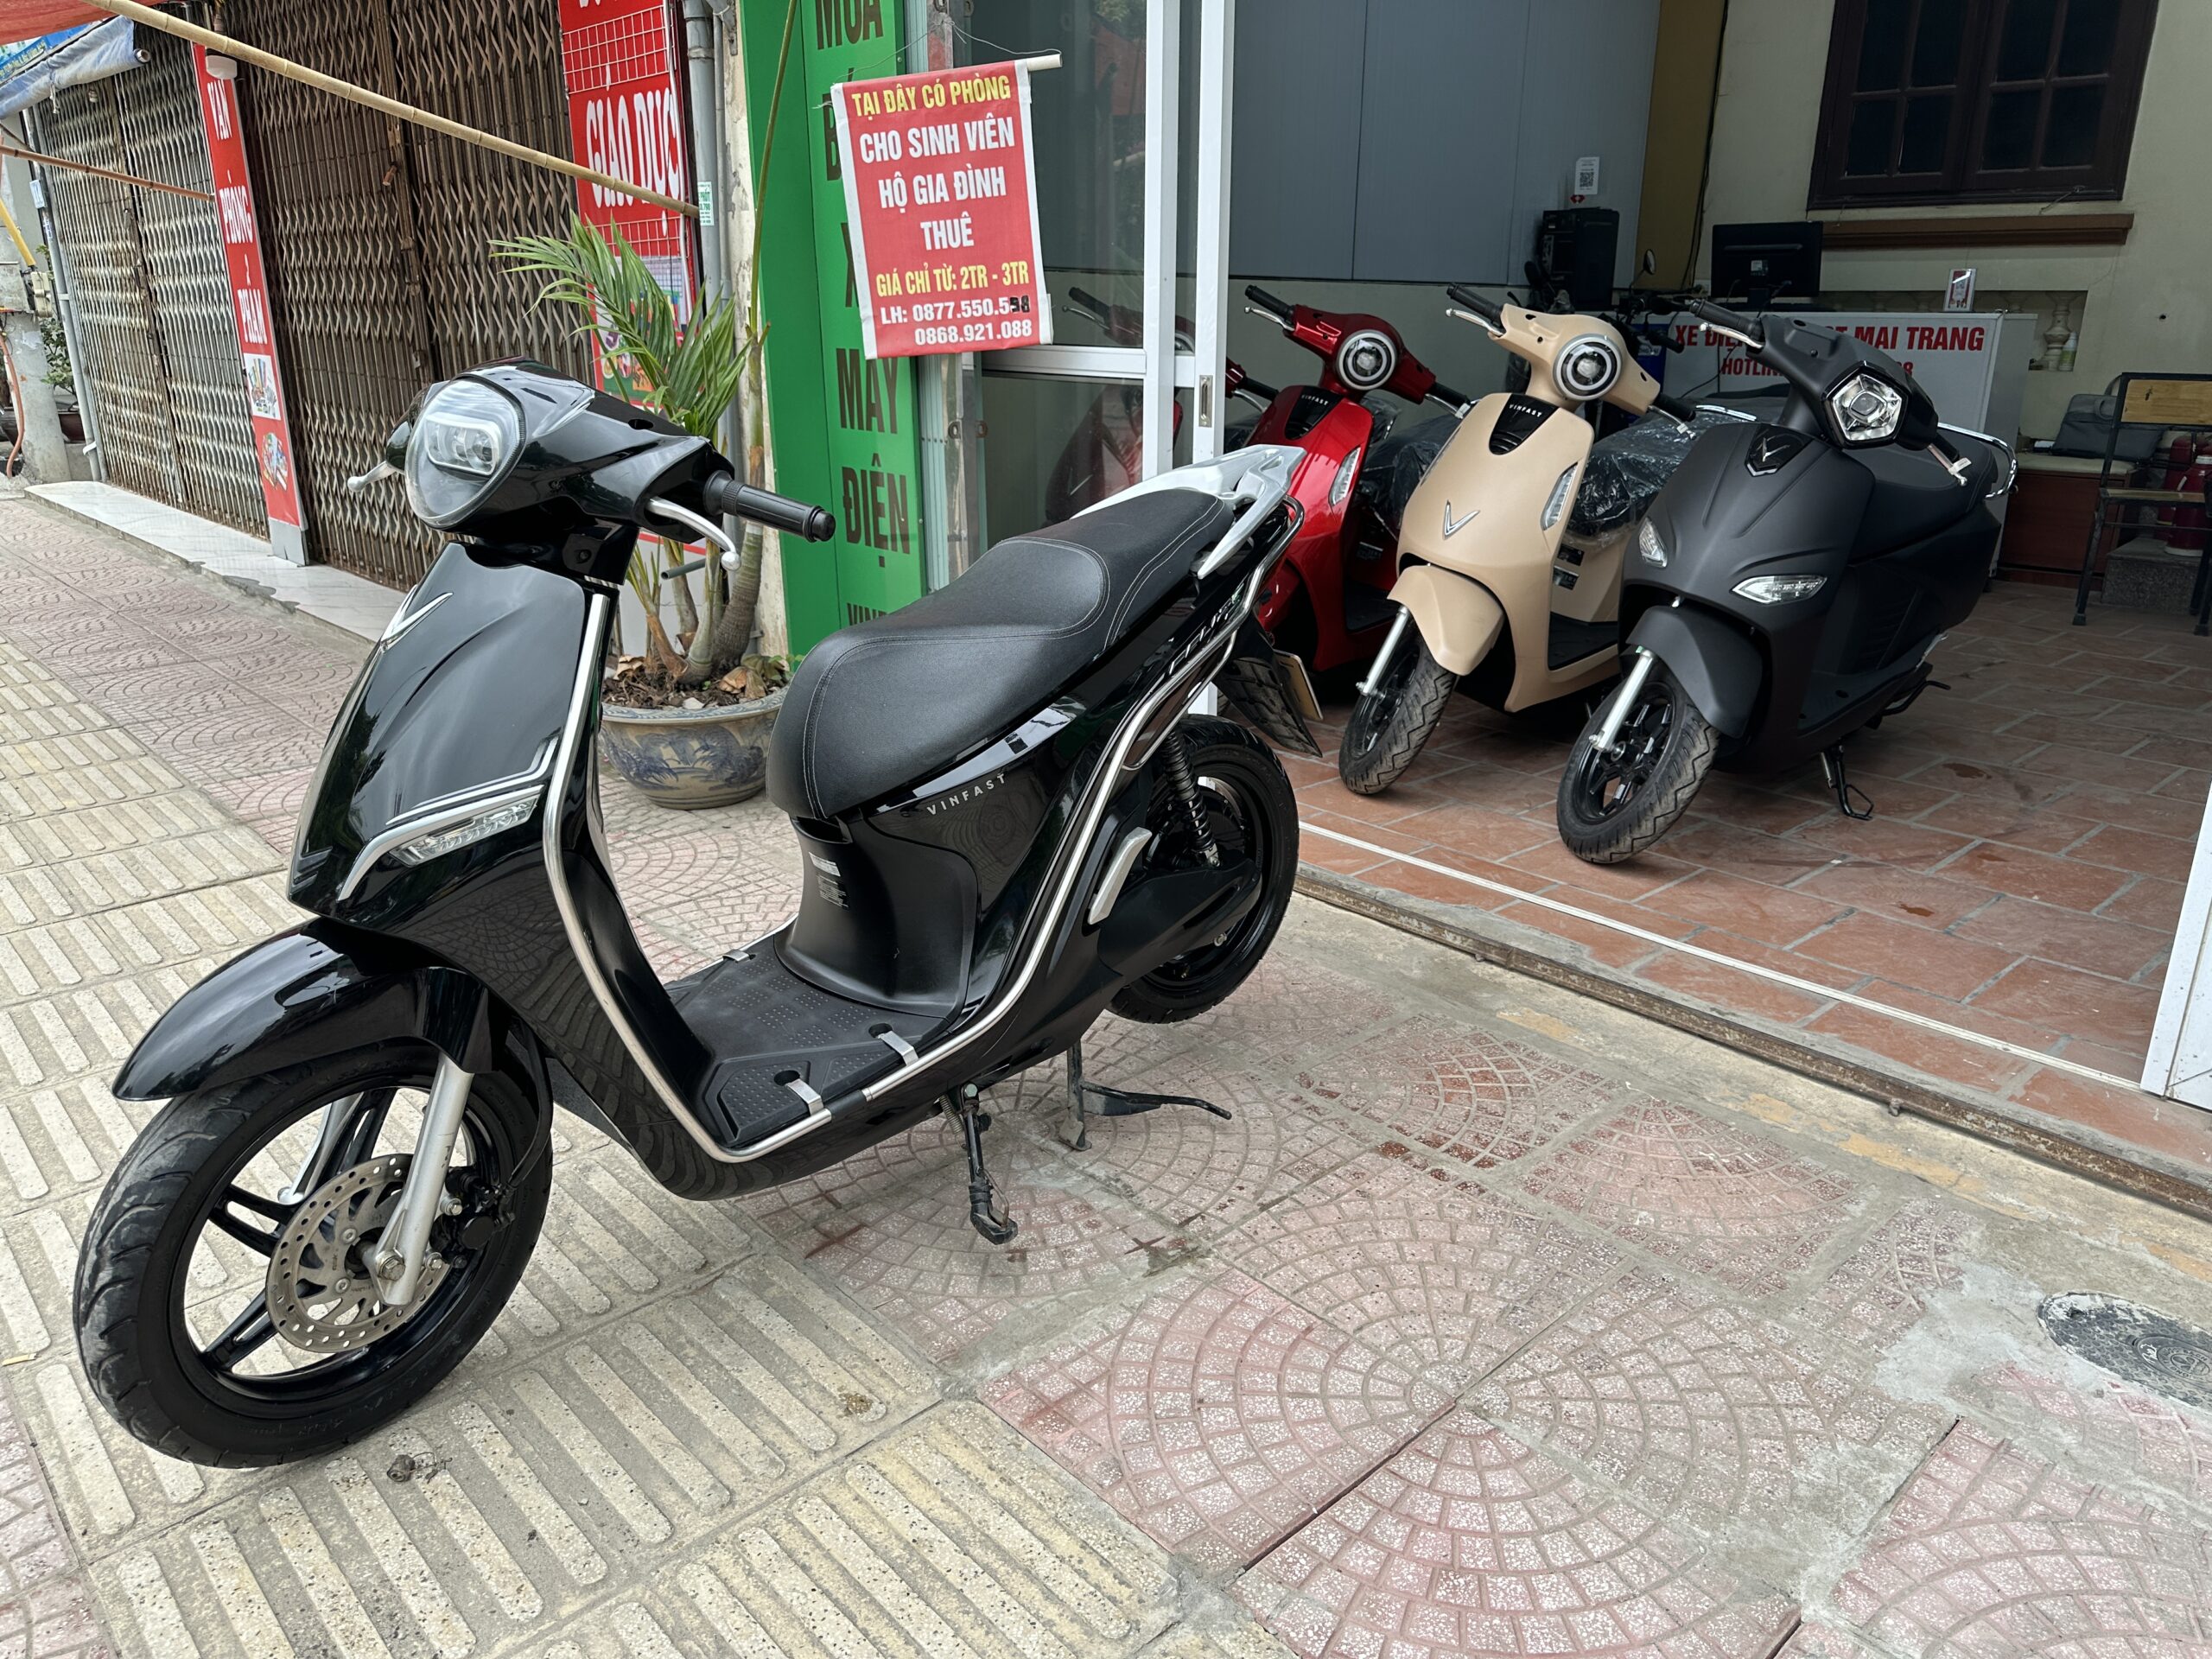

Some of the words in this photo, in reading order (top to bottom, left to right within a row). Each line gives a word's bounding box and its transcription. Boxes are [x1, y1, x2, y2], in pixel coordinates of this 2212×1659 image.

[851, 91, 880, 121] TẠI
[884, 83, 917, 113] ĐÂY
[921, 80, 946, 109] CÓ
[950, 73, 1011, 105] PHÒNG
[586, 64, 634, 209] GIÁO
[633, 86, 681, 237] DỤC
[859, 130, 902, 164] CHO
[907, 123, 961, 158] SINH
[963, 111, 1015, 151] VIÊN
[878, 171, 908, 213] HỘ
[912, 173, 950, 206] GIA
[953, 162, 1007, 201] ĐÌNH
[920, 211, 975, 251] THUÊ
[875, 268, 903, 297] GIÁ
[905, 262, 931, 295] CHỈ
[933, 264, 957, 292] TỪ:
[960, 264, 988, 289] 2TR
[1001, 260, 1030, 286] 3TR
[880, 305, 908, 325] LH:
[914, 319, 1033, 346] 0868.921.088
[1854, 326, 1899, 350] MAI
[1906, 326, 1985, 352] TRANG
[1509, 404, 1543, 417] VINFAST
[842, 453, 911, 568] ĐIỆN
[926, 773, 1005, 816] VINFAST
